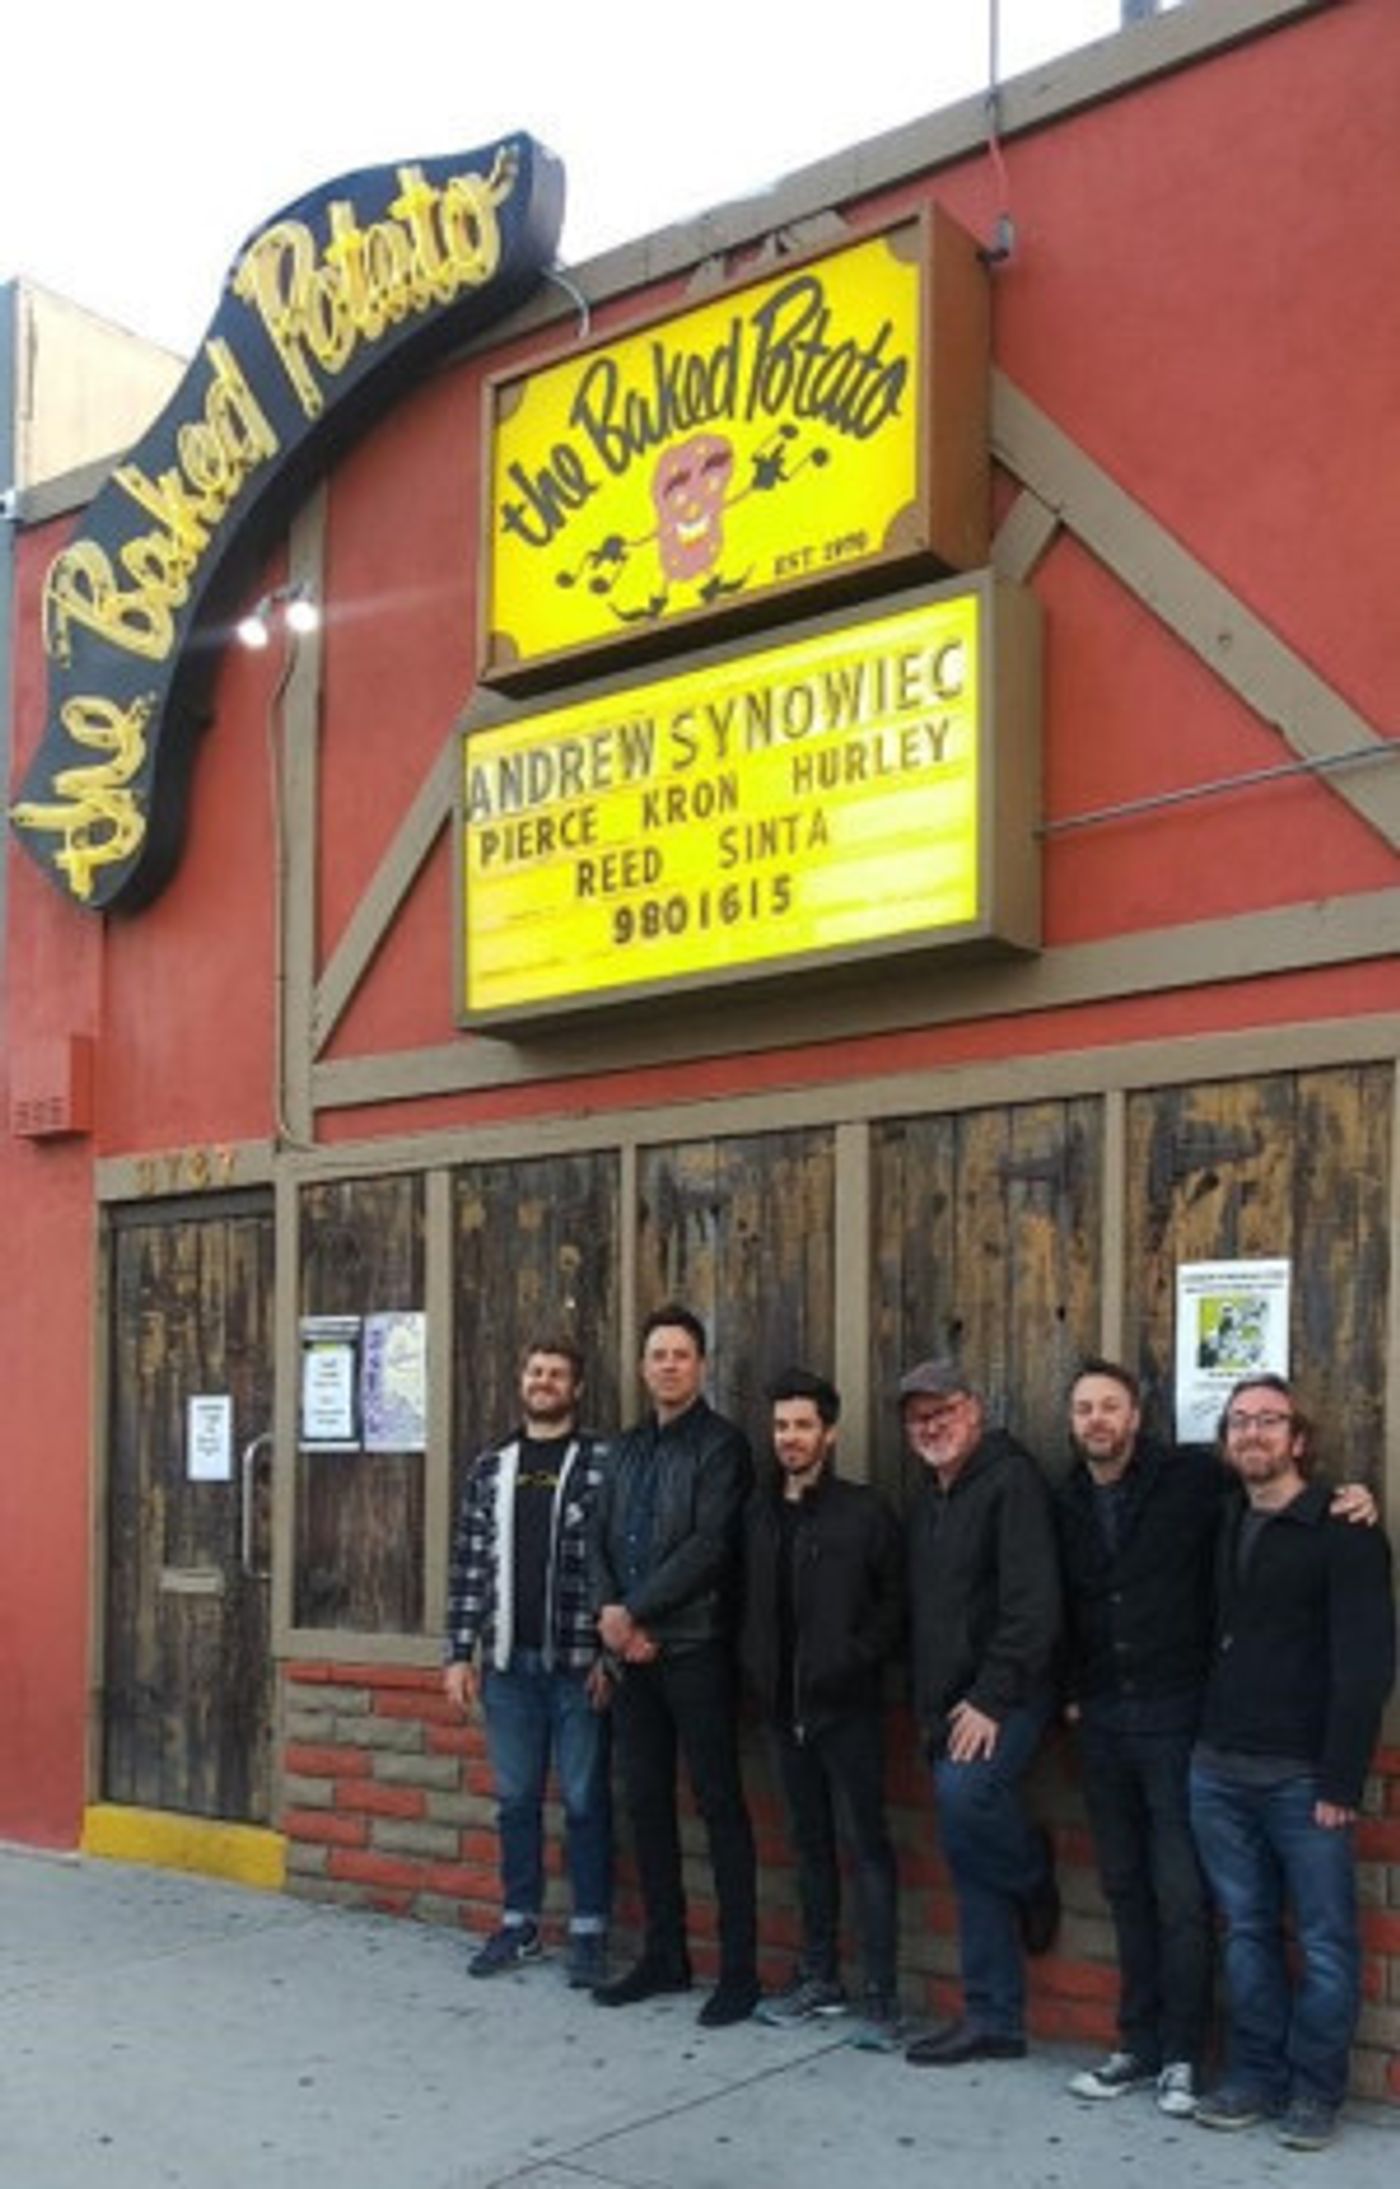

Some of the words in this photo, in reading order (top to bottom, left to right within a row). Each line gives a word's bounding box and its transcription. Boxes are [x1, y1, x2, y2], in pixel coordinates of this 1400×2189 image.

[234, 146, 520, 419] Potato
[43, 338, 278, 665] Baked
[501, 442, 599, 548] the
[572, 318, 742, 474] Baked
[748, 276, 906, 438] Potato
[10, 692, 156, 903] the
[464, 717, 657, 821] ANDREW
[671, 639, 965, 771] SYNOWIEC
[479, 804, 598, 868] PIERCE
[641, 771, 740, 831] KRON
[791, 720, 952, 794] HURLEY
[575, 848, 664, 899] REED
[719, 809, 831, 868] SINTA
